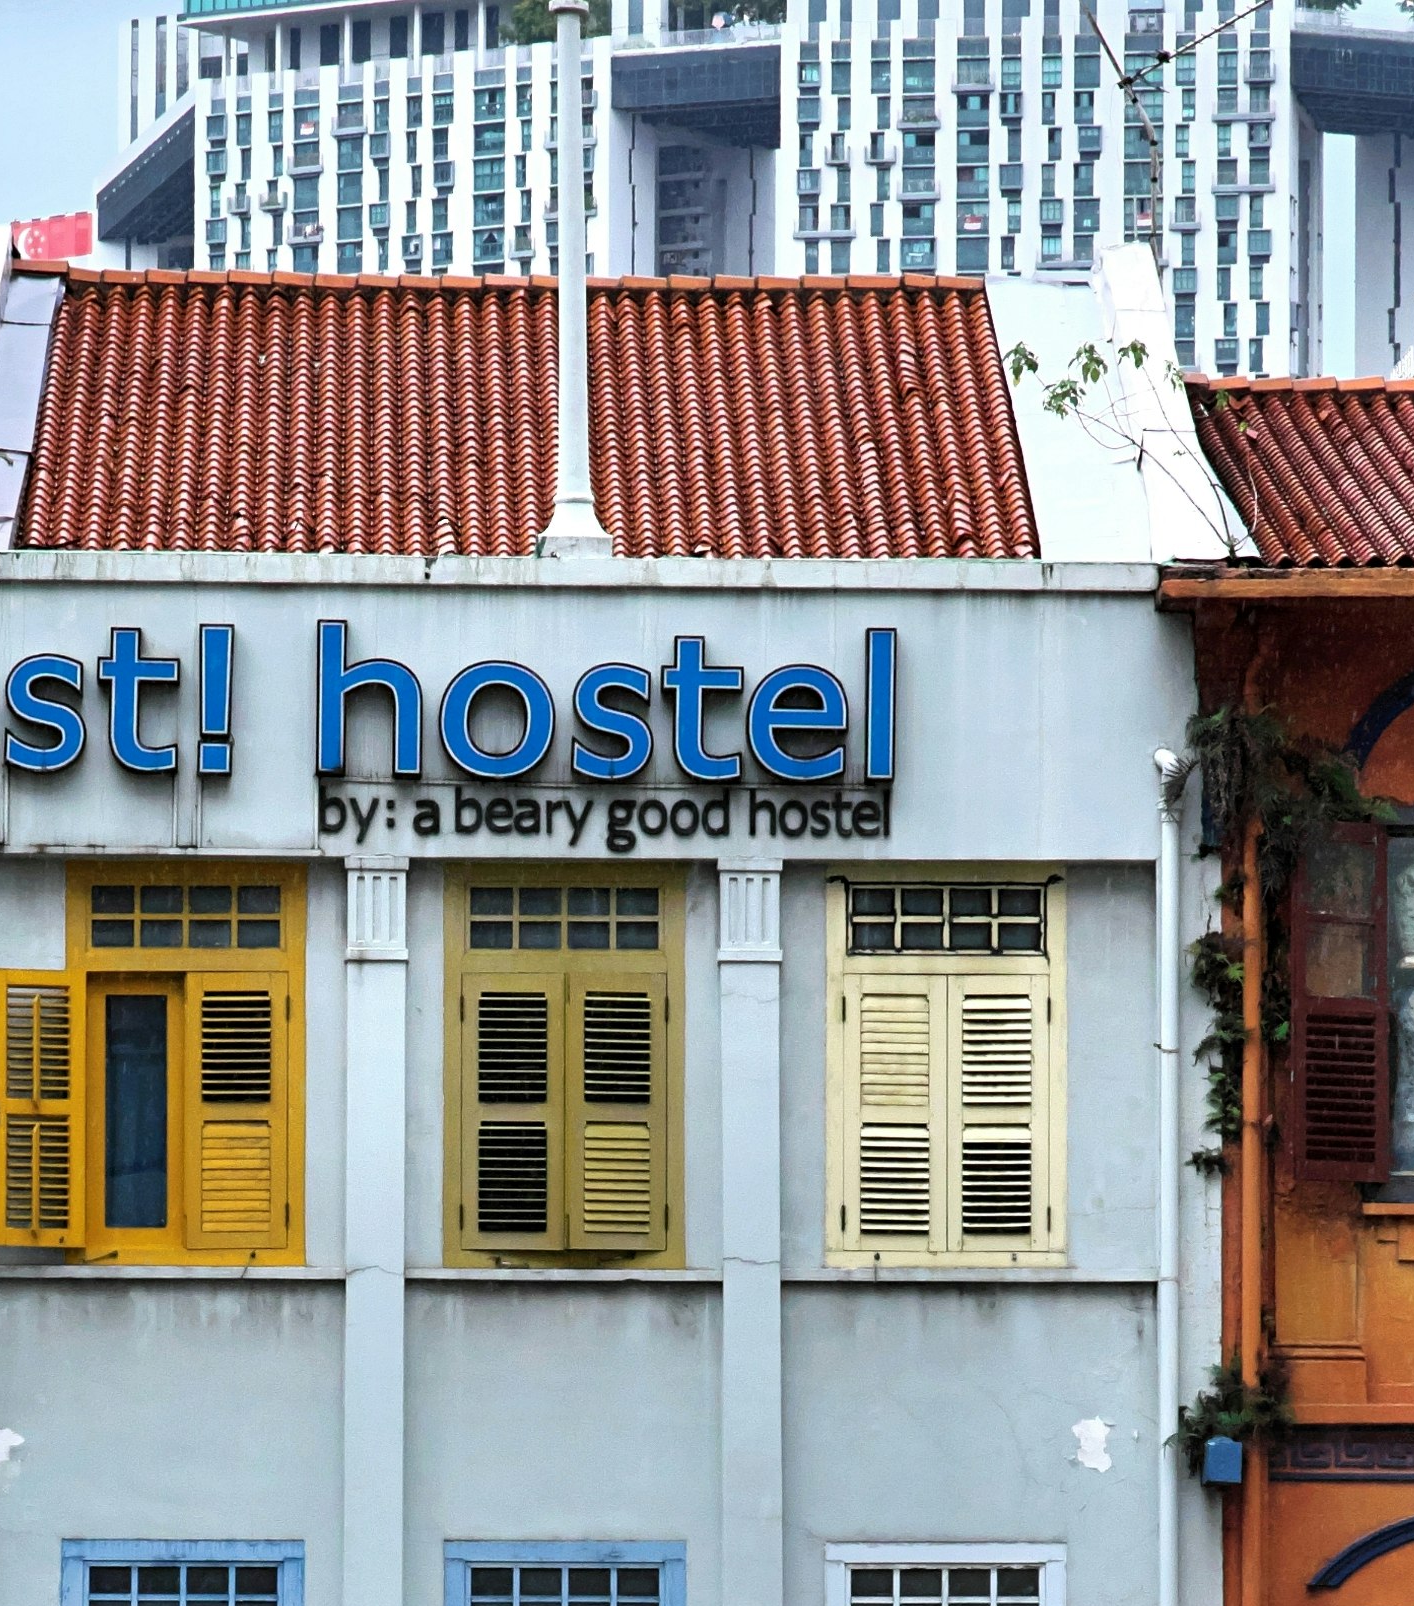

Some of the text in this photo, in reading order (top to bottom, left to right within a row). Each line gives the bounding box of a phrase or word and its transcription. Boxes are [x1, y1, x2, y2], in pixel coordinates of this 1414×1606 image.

[316, 619, 897, 782] hostel
[319, 787, 891, 852] by: a beary good hostel
